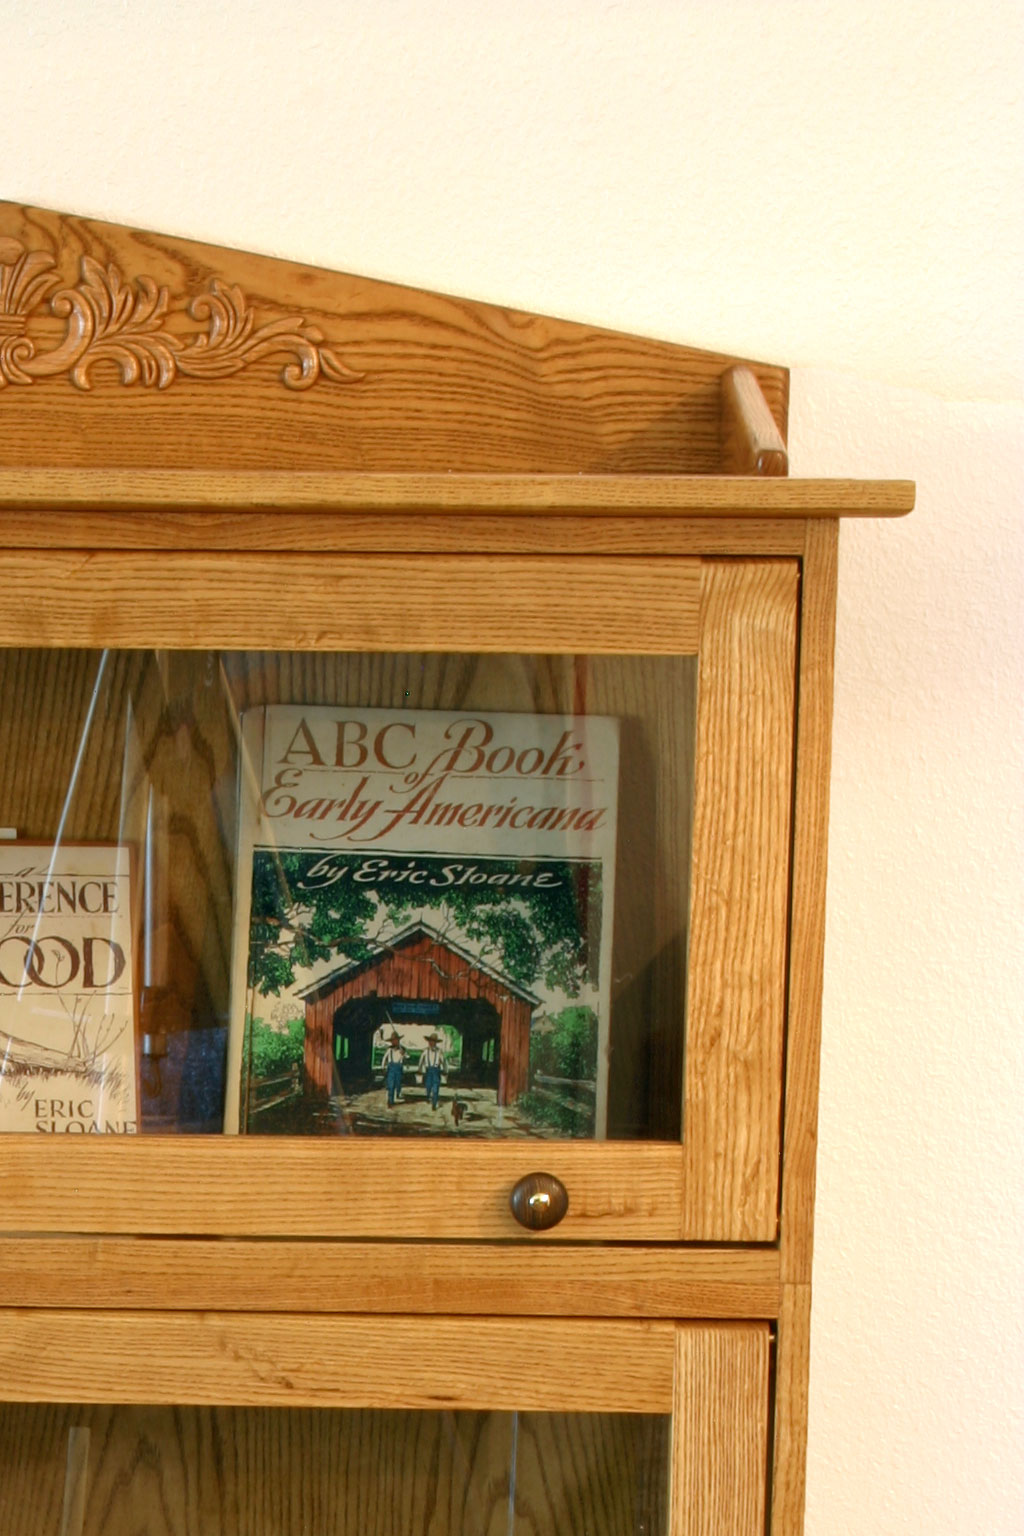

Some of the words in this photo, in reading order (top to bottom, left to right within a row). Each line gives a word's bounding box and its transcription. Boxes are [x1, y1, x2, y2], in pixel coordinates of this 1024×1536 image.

[278, 717, 417, 770] ABC
[443, 718, 585, 777] Book
[389, 748, 466, 794] of
[262, 768, 385, 841] Early
[347, 773, 609, 842] Americana
[297, 851, 349, 889] by
[353, 859, 428, 884] Eric
[16, 1081, 35, 1112] by
[34, 1099, 94, 1118] ERIC
